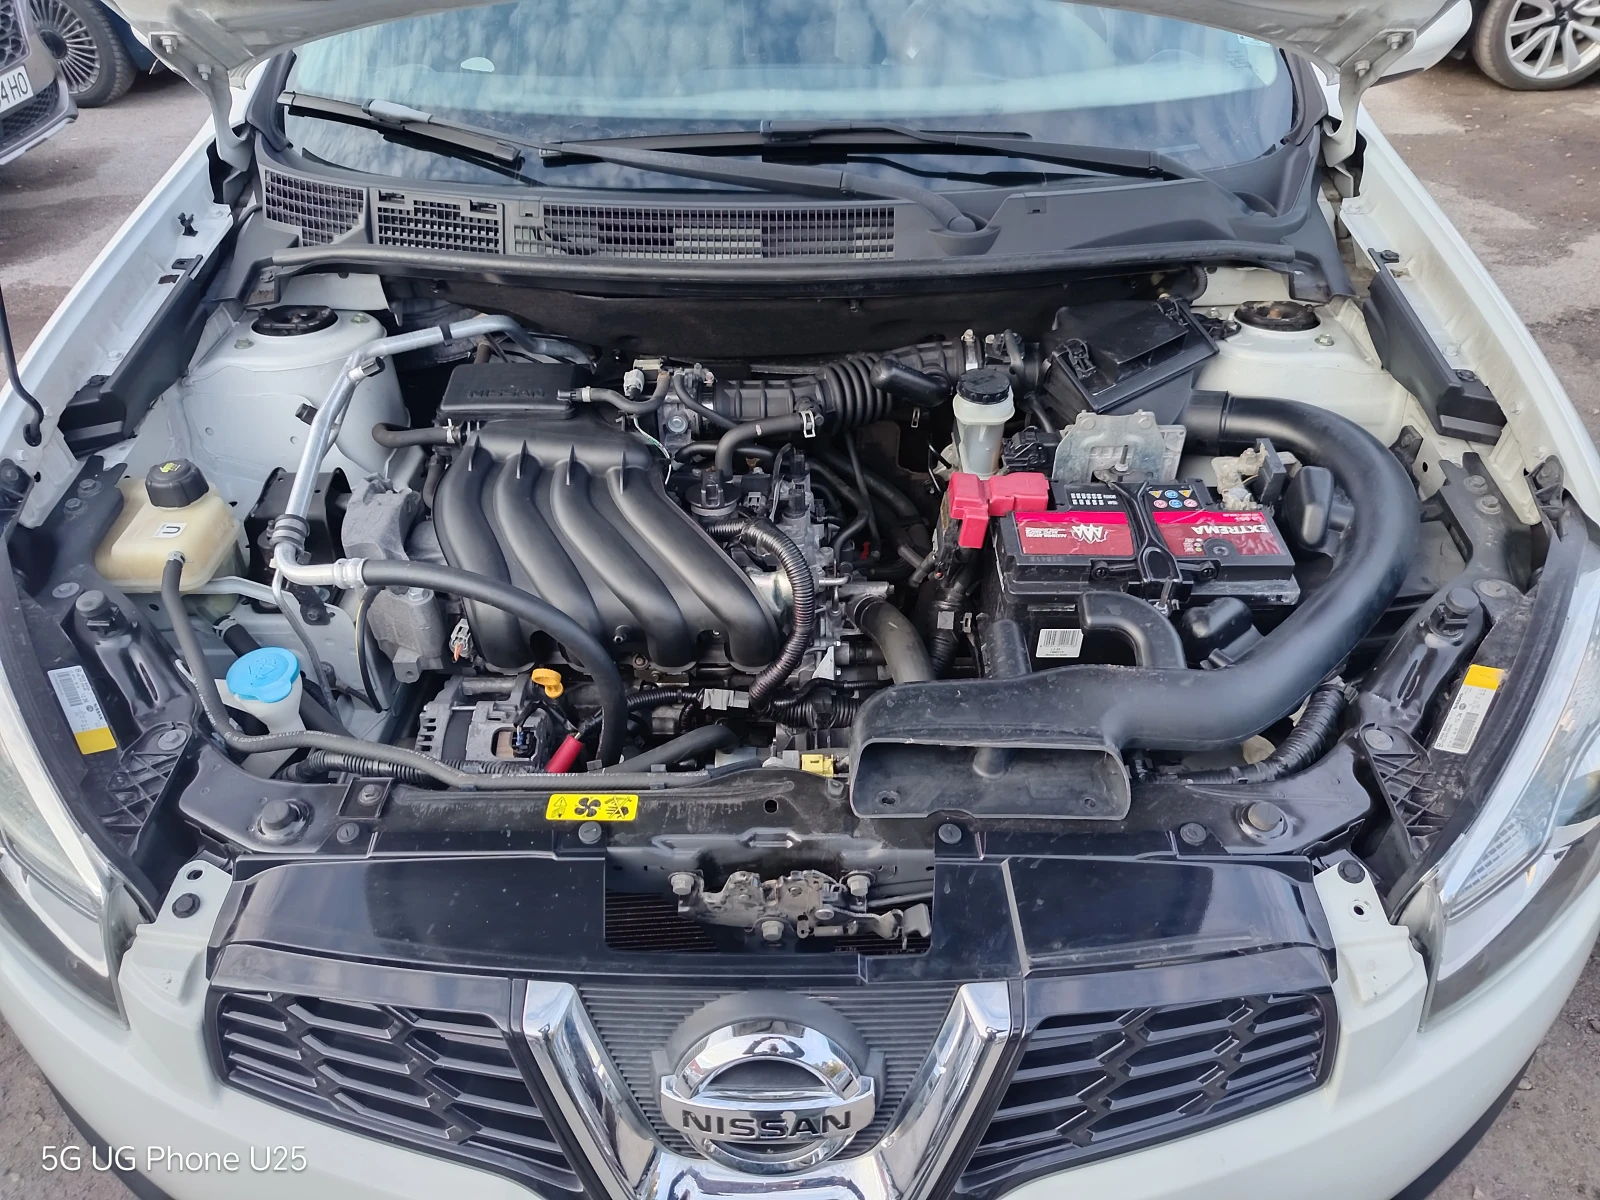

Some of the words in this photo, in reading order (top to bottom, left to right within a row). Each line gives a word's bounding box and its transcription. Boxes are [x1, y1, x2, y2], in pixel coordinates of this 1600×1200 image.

[466, 388, 546, 398] NISSAN
[1191, 525, 1269, 535] EXTREMA
[682, 1109, 852, 1138] NISSAN
